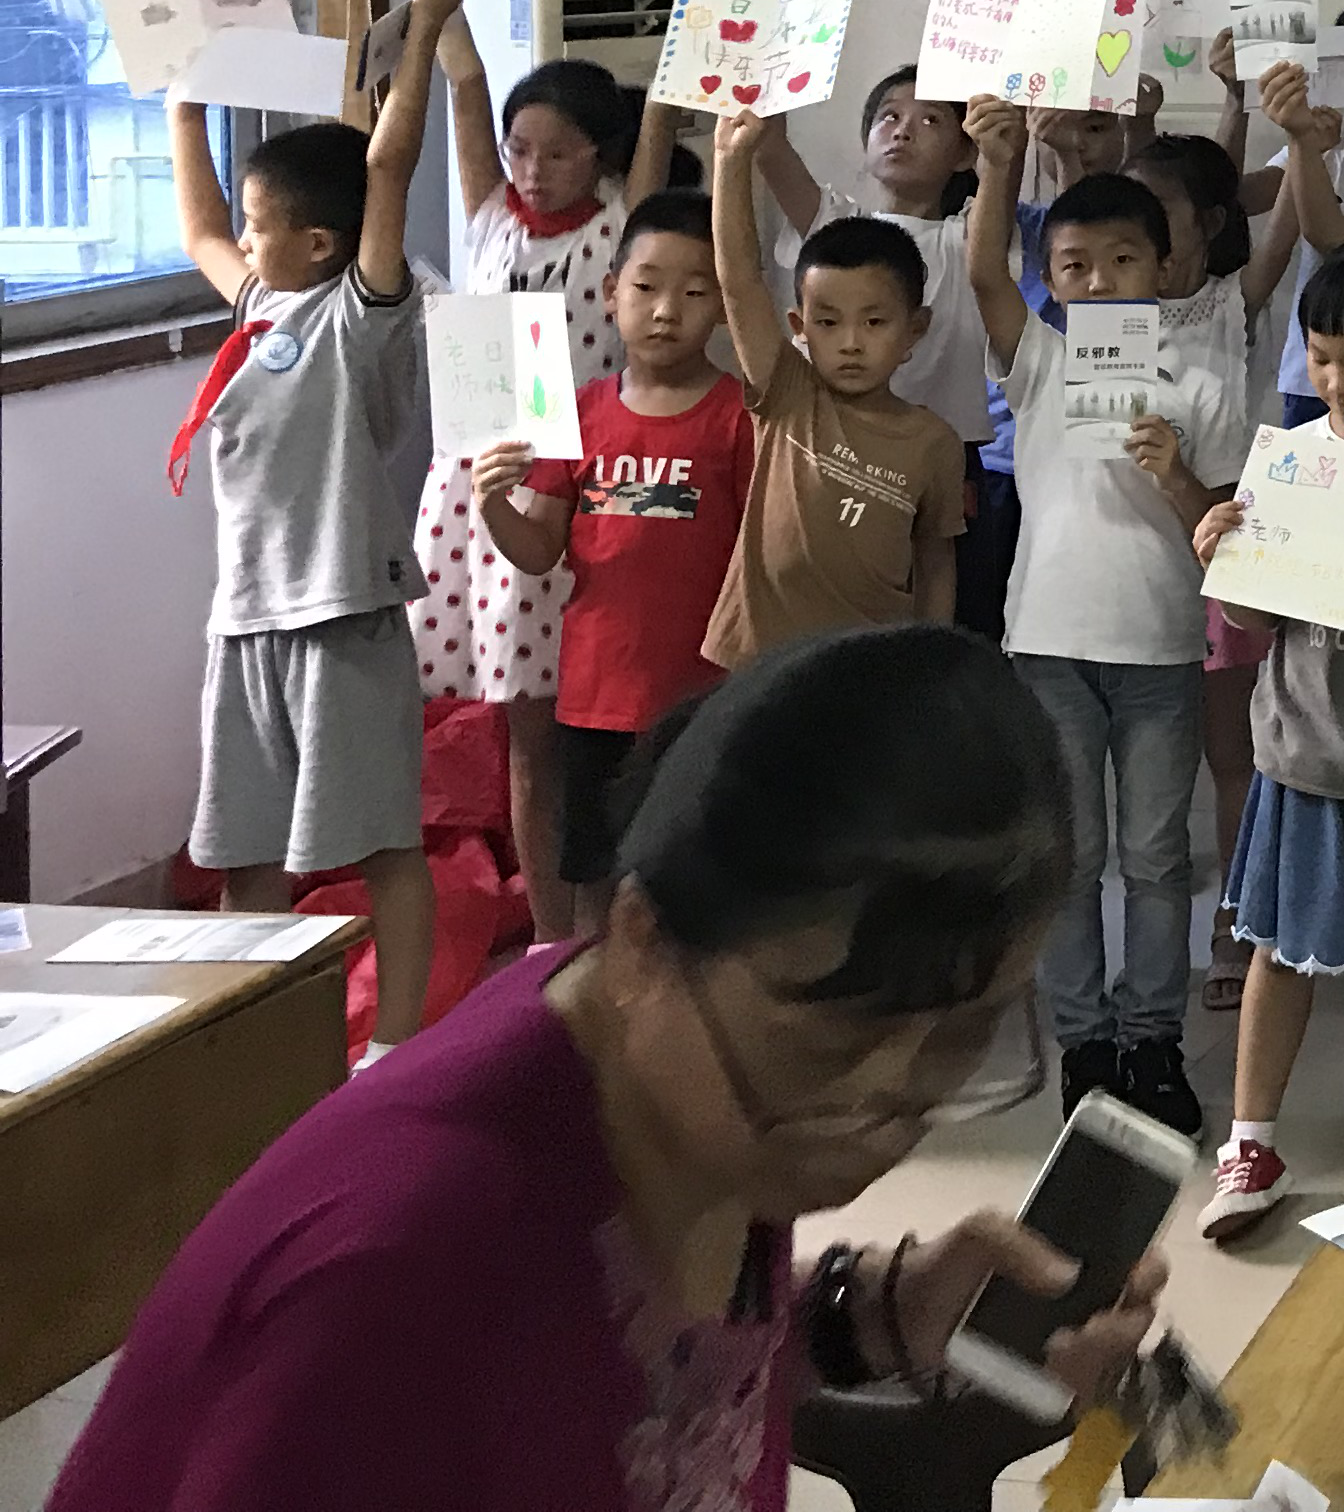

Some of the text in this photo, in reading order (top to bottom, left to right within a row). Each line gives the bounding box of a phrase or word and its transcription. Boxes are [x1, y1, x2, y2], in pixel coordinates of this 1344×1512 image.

[1076, 346, 1121, 360] 反邪教
[595, 455, 693, 486] LOVE
[832, 443, 907, 487] REMRKING
[1232, 518, 1292, 544] 老师
